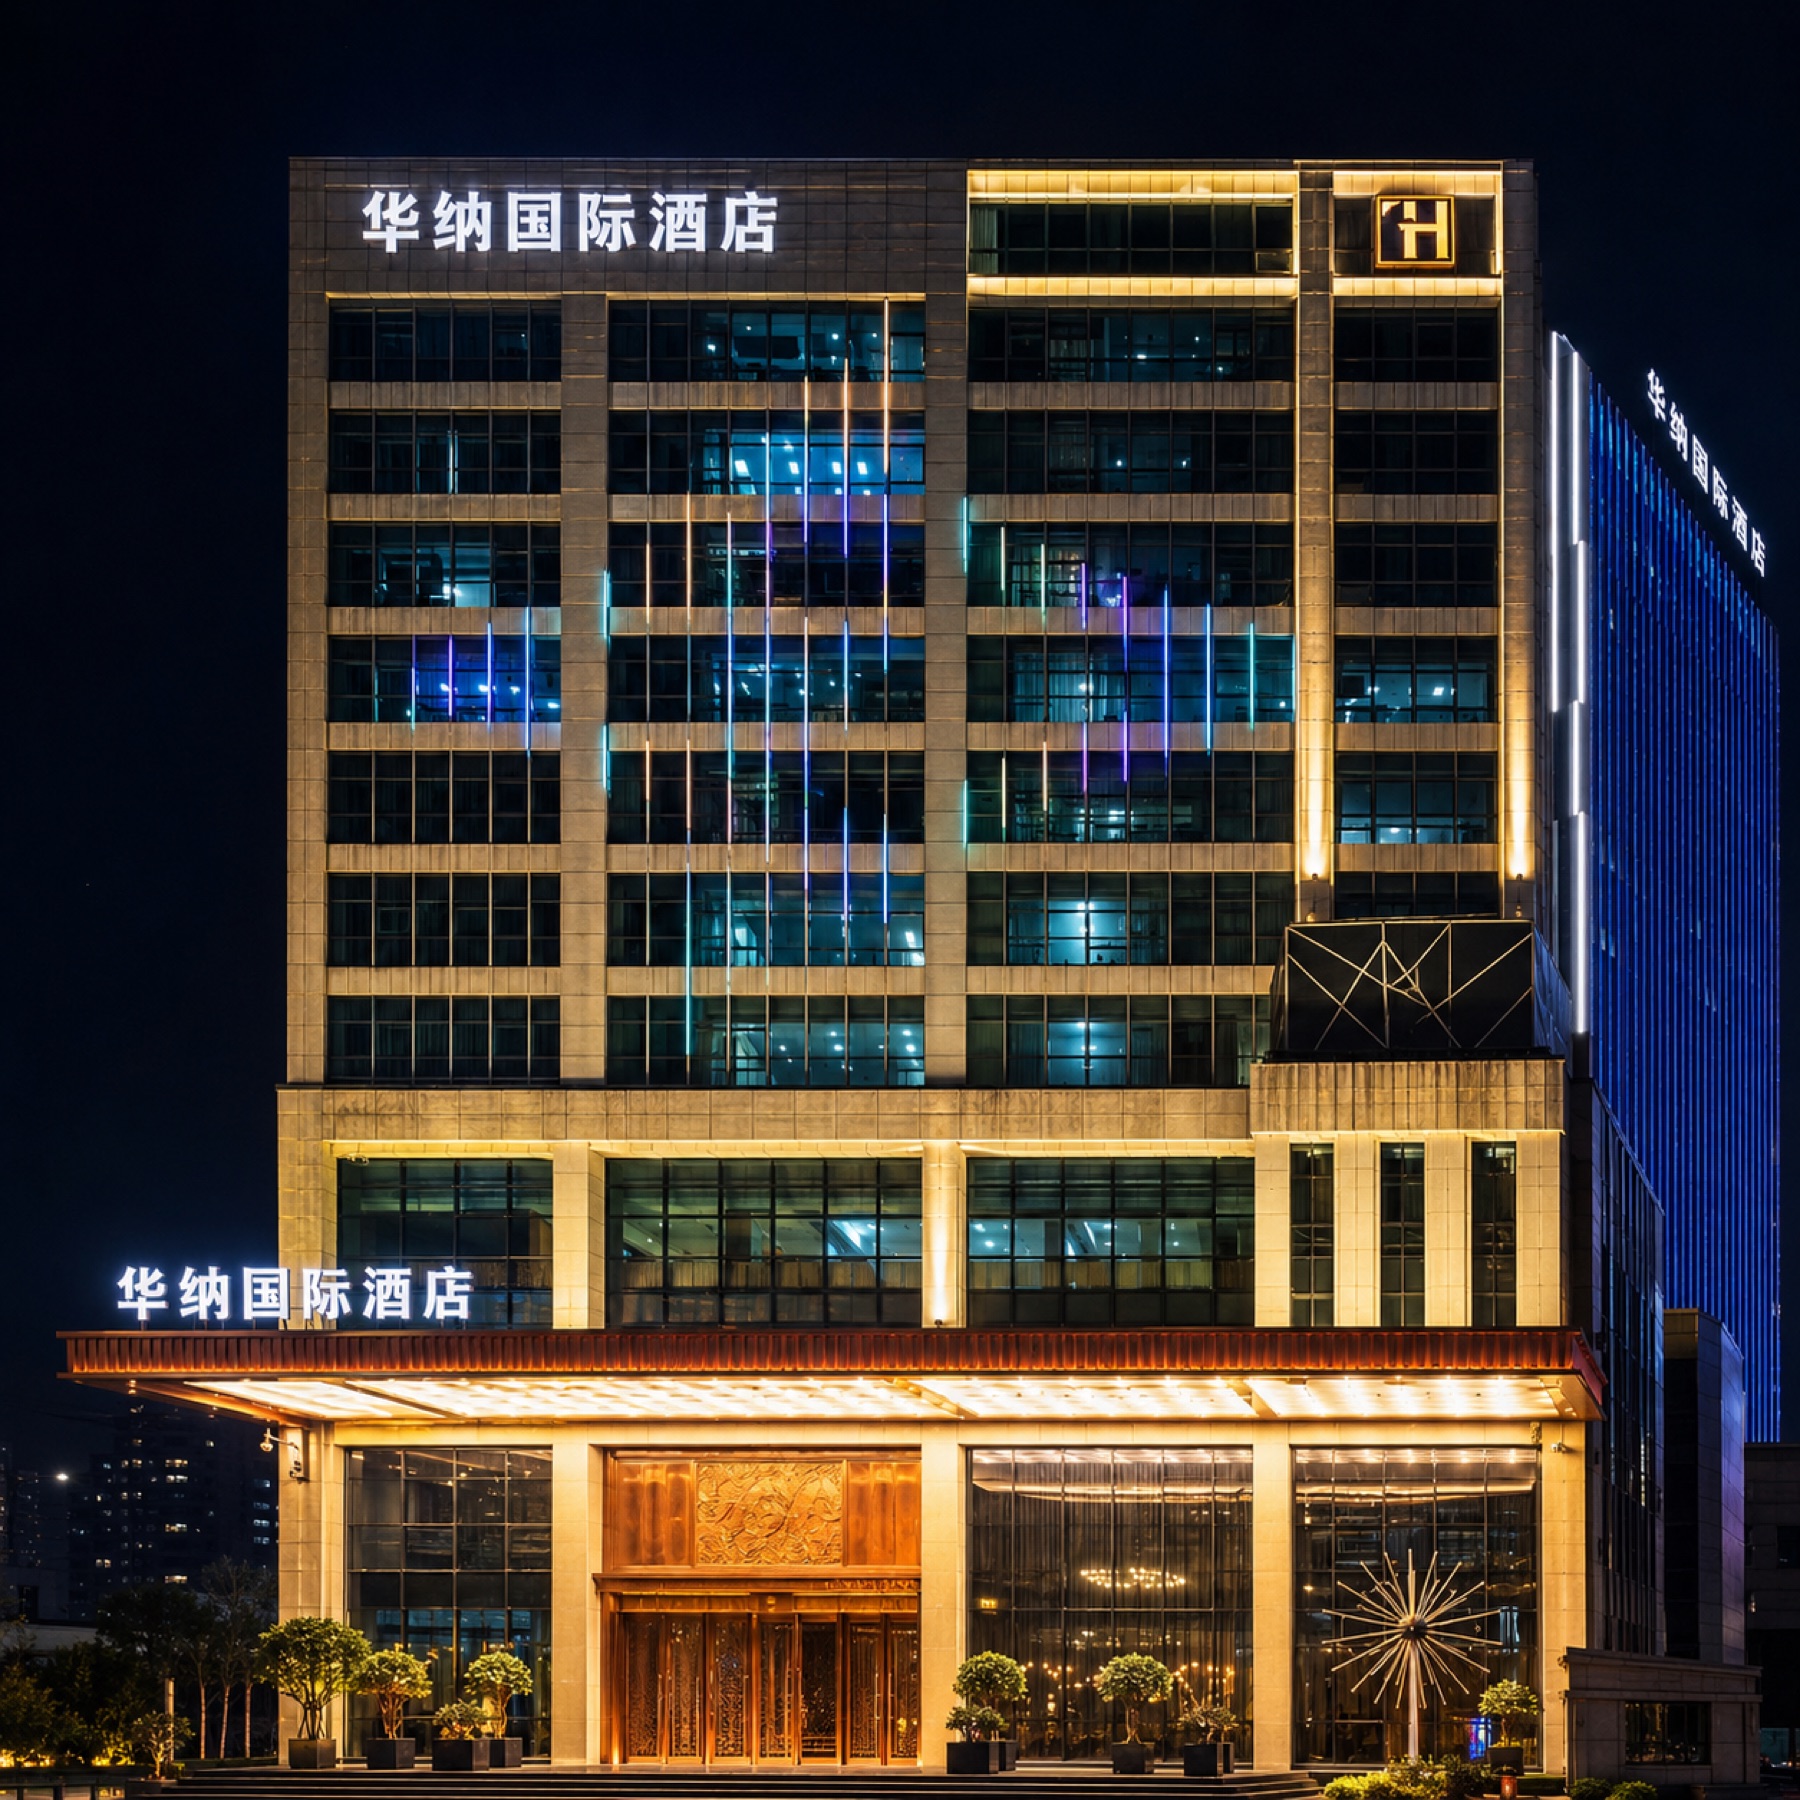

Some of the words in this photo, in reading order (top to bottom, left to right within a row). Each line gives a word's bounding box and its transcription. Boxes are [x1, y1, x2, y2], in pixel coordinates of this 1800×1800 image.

[362, 190, 778, 254] 华纳国际酒店
[1647, 368, 1766, 577] 华纳国际酒店
[117, 1265, 474, 1321] 华纳国际酒店
